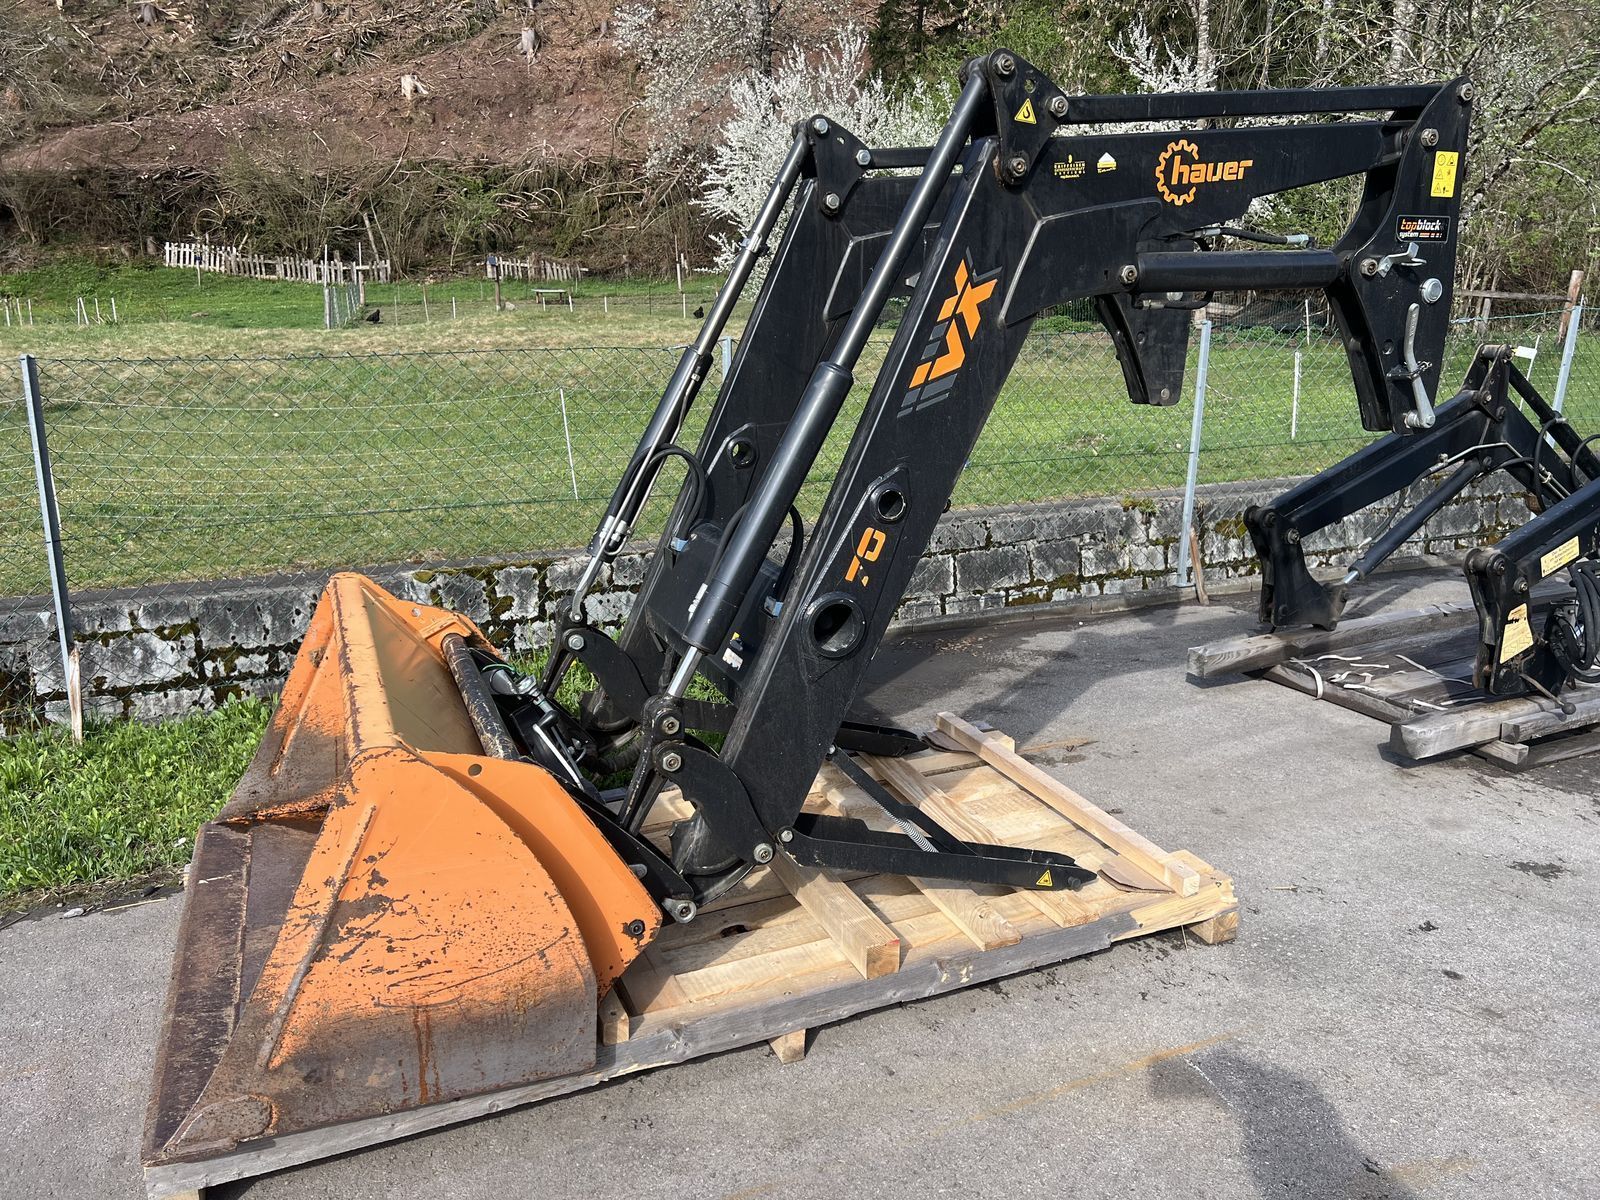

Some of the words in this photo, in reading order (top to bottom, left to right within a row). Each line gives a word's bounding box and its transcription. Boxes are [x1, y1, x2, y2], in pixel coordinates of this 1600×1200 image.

[1171, 155, 1253, 184] hauer
[1399, 231, 1419, 239] system
[1400, 219, 1441, 232] topblock
[909, 259, 998, 388] VX
[845, 527, 886, 587] 70
